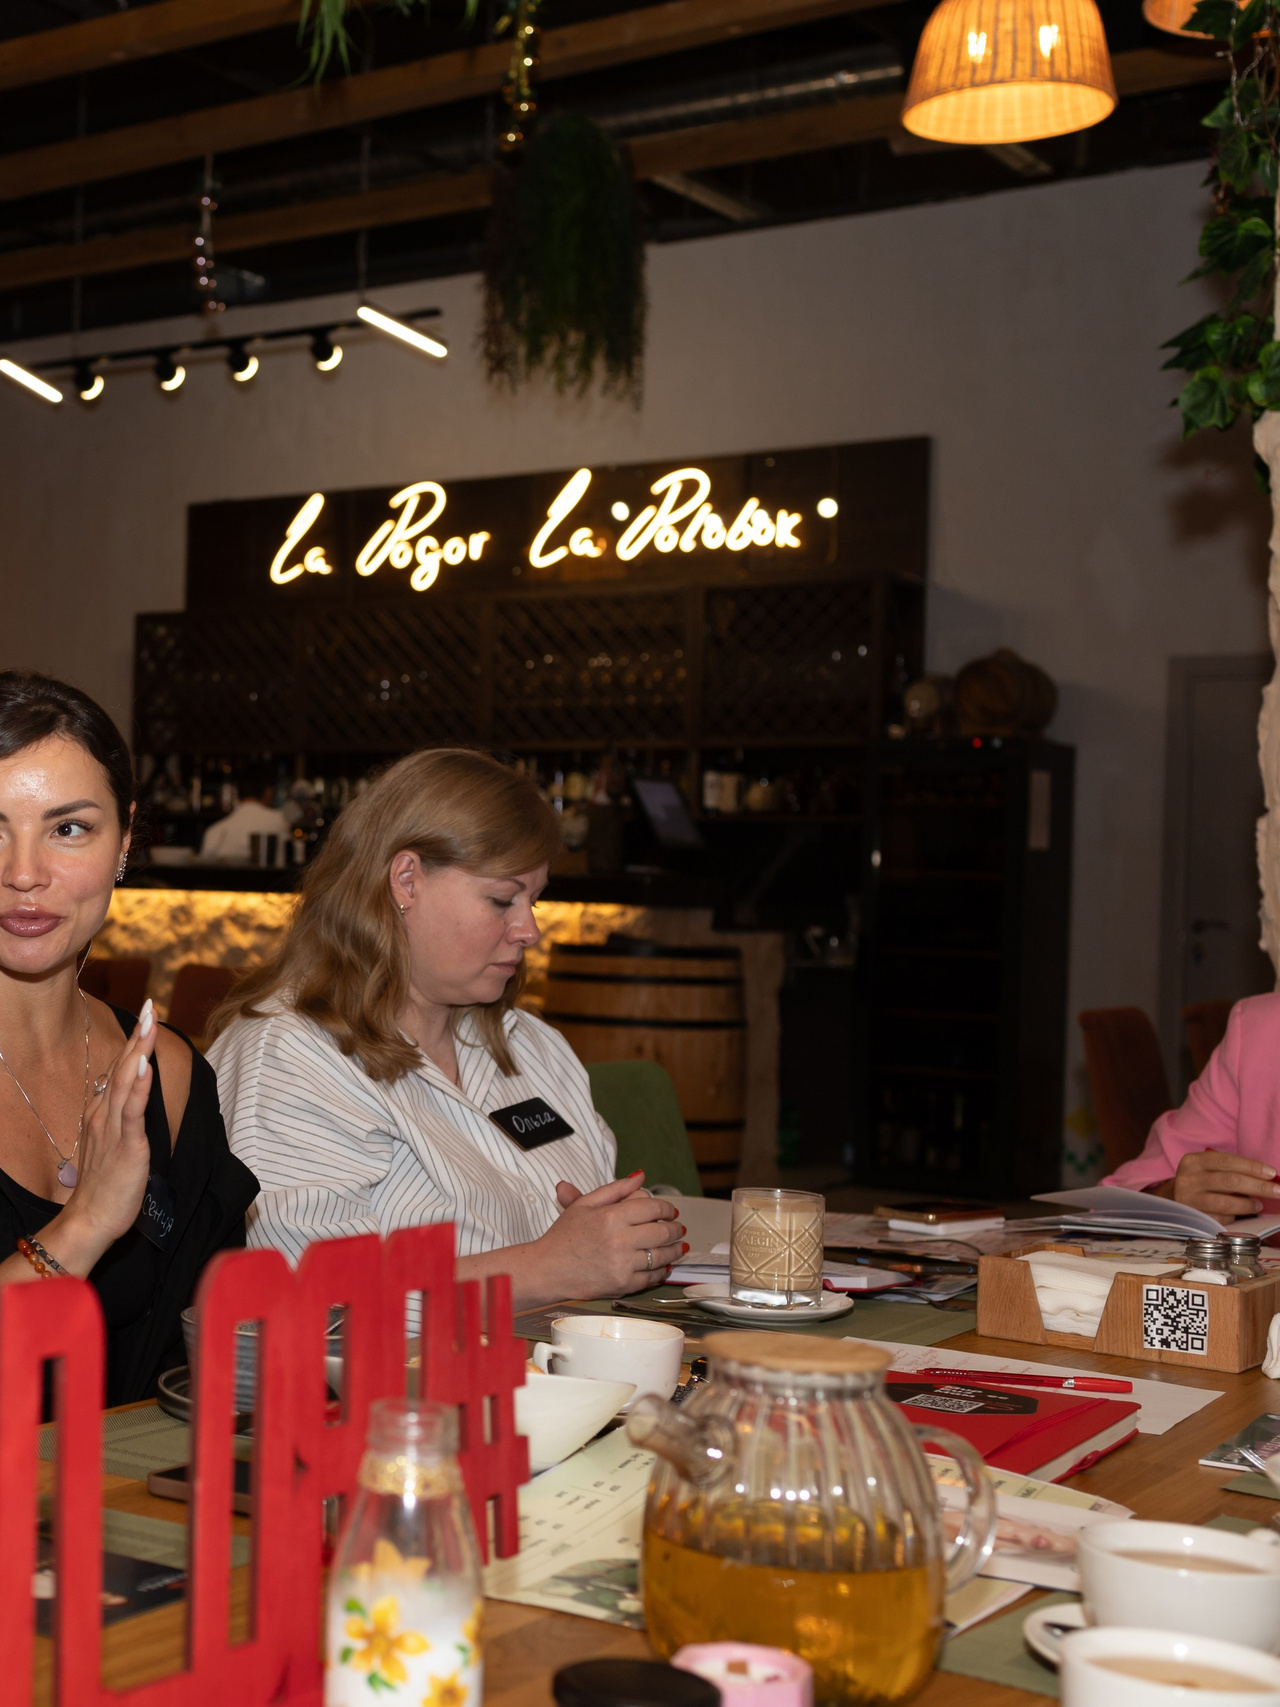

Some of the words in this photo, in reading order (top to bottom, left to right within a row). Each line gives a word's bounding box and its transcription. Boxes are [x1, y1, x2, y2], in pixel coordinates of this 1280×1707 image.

[269, 491, 334, 585] La
[527, 467, 606, 570] La
[511, 1110, 556, 1134] Ольга
[142, 1175, 175, 1238] сения
